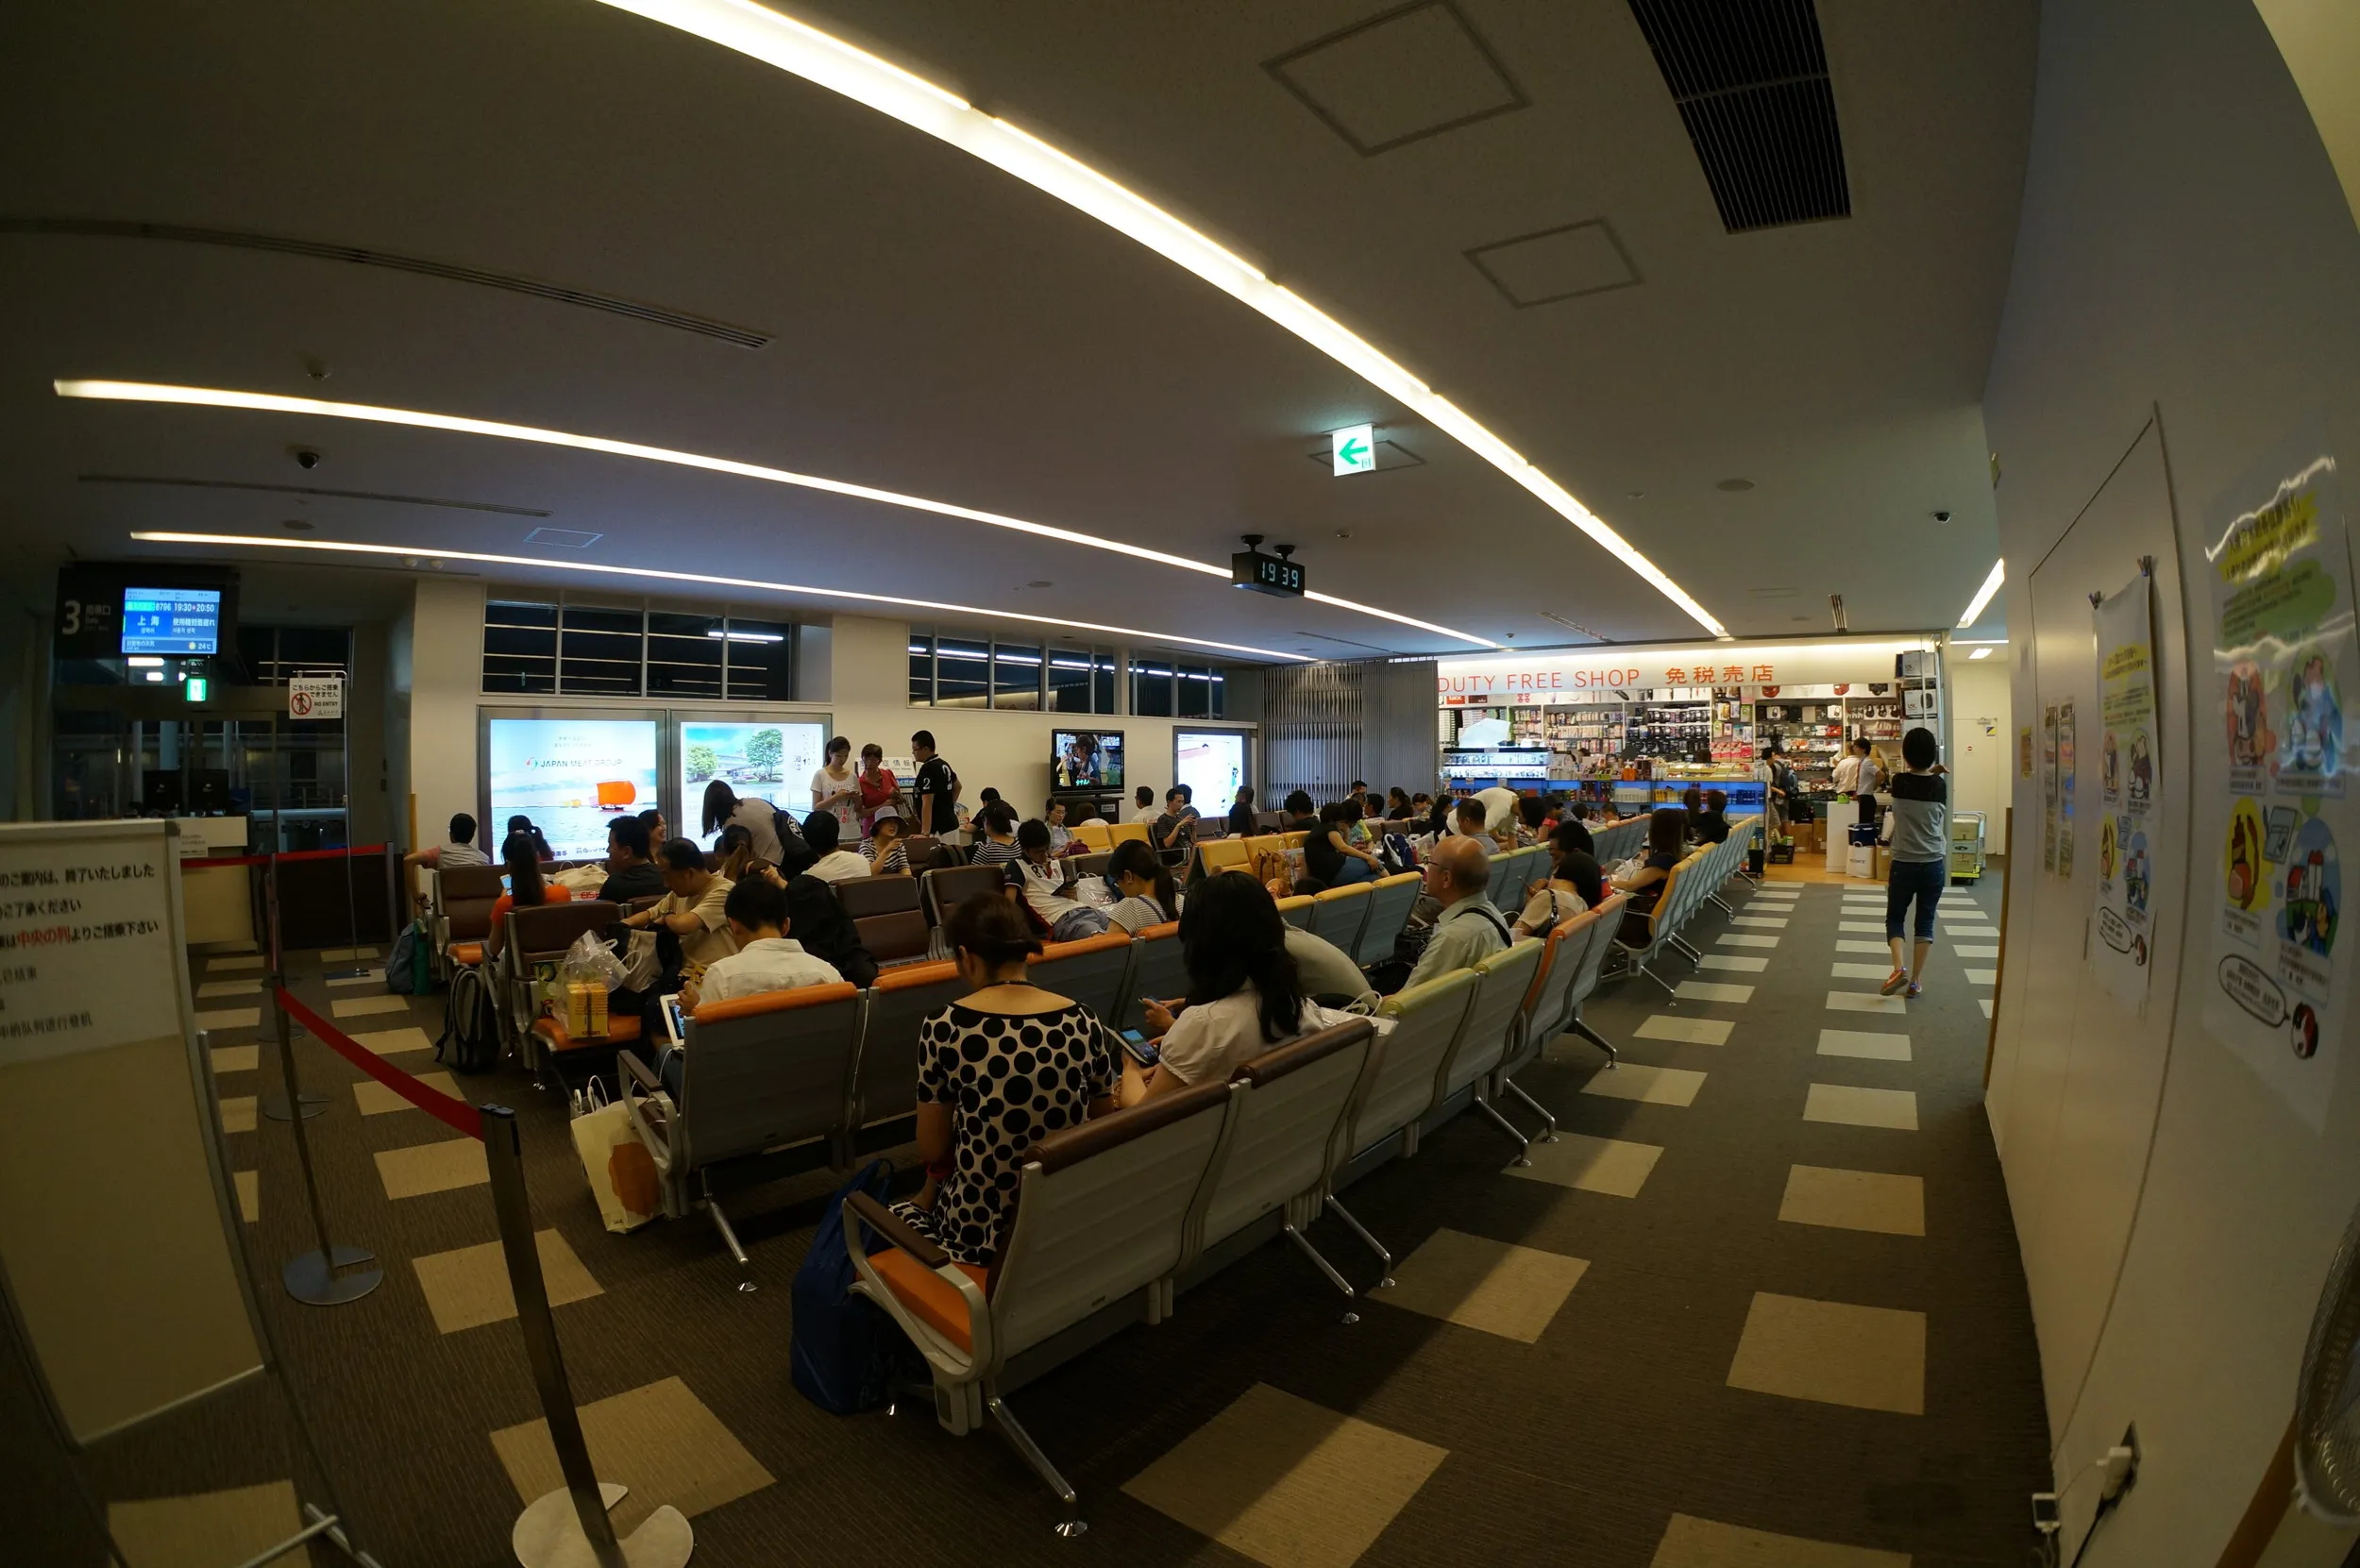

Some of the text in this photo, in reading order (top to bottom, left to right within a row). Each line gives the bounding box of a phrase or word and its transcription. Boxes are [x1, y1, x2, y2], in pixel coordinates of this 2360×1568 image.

[62, 599, 81, 635] 3
[174, 602, 192, 612] 19:30
[195, 603, 215, 613] 20:50
[1438, 668, 1640, 693] DUTY FREE SHOP
[1665, 665, 1774, 684] 免税売店
[570, 759, 593, 767] MEAT
[595, 758, 623, 767] GROUP
[922, 777, 931, 790] 2
[0, 899, 81, 919] ご了承ください
